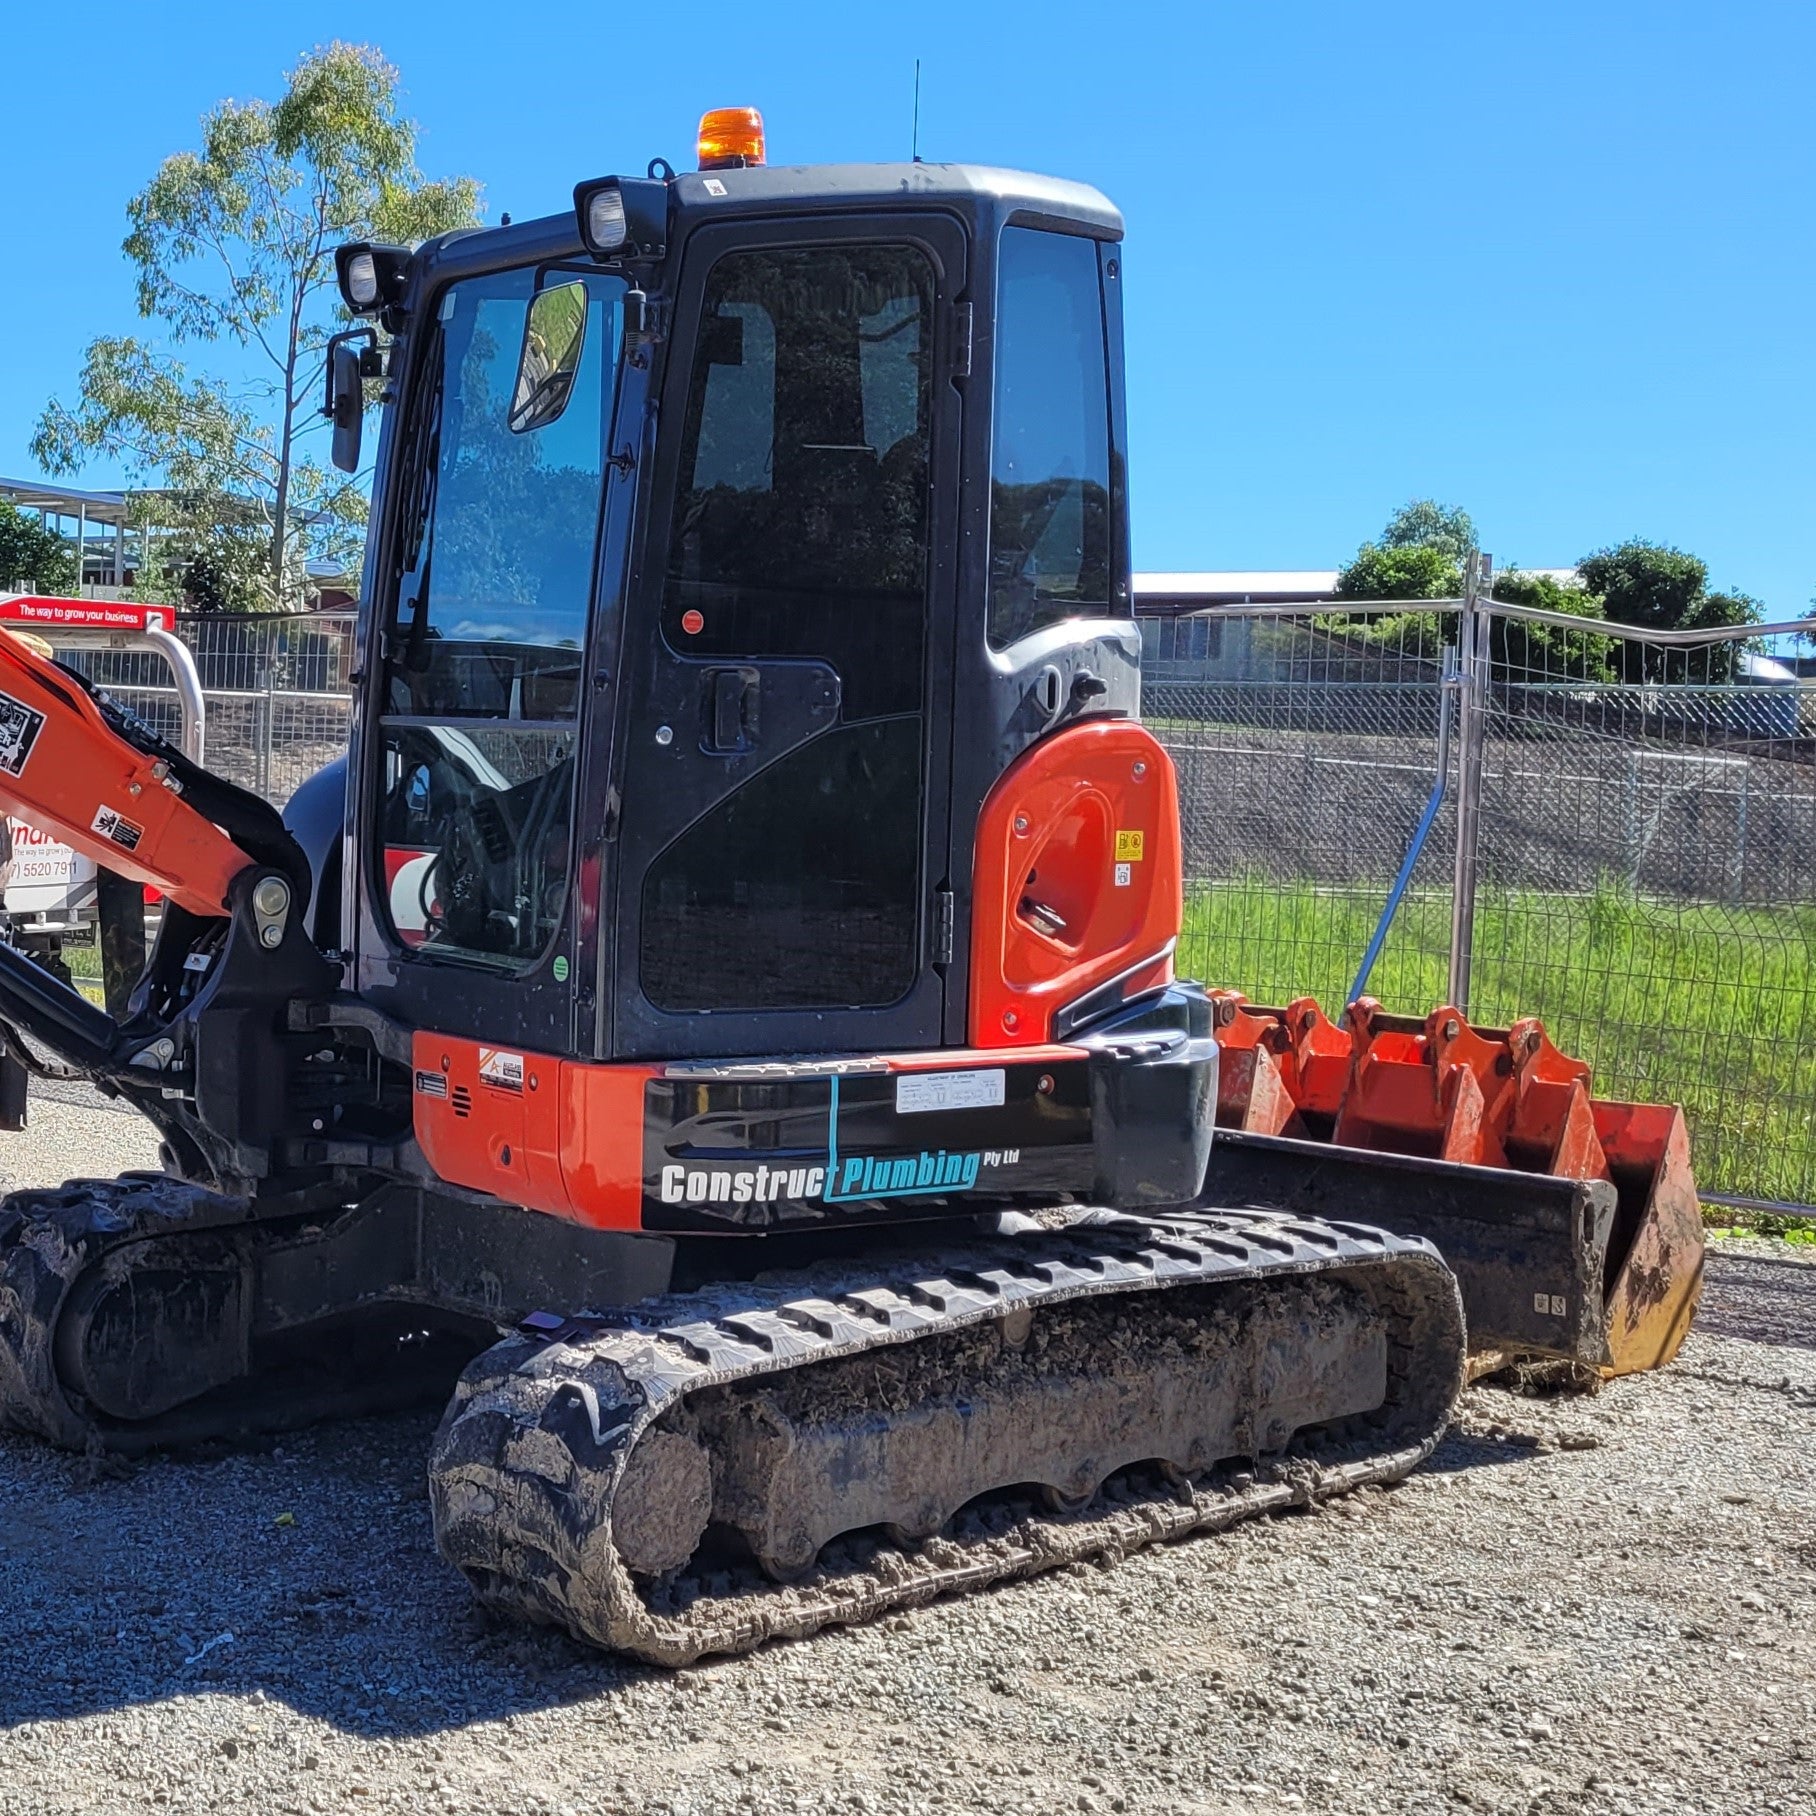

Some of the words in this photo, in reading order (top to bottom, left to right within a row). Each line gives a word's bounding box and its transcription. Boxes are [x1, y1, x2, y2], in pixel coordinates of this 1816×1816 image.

[19, 604, 36, 616] The
[36, 607, 53, 619] way
[54, 607, 64, 618] to
[64, 608, 86, 621] grow
[86, 610, 105, 621] your
[105, 609, 139, 624] business
[23, 862, 52, 877] 5520
[661, 1160, 840, 1204] Construct
[841, 1150, 980, 1195] Plumbing
[983, 1151, 1001, 1168] Pty
[1003, 1149, 1020, 1164] Ltd
